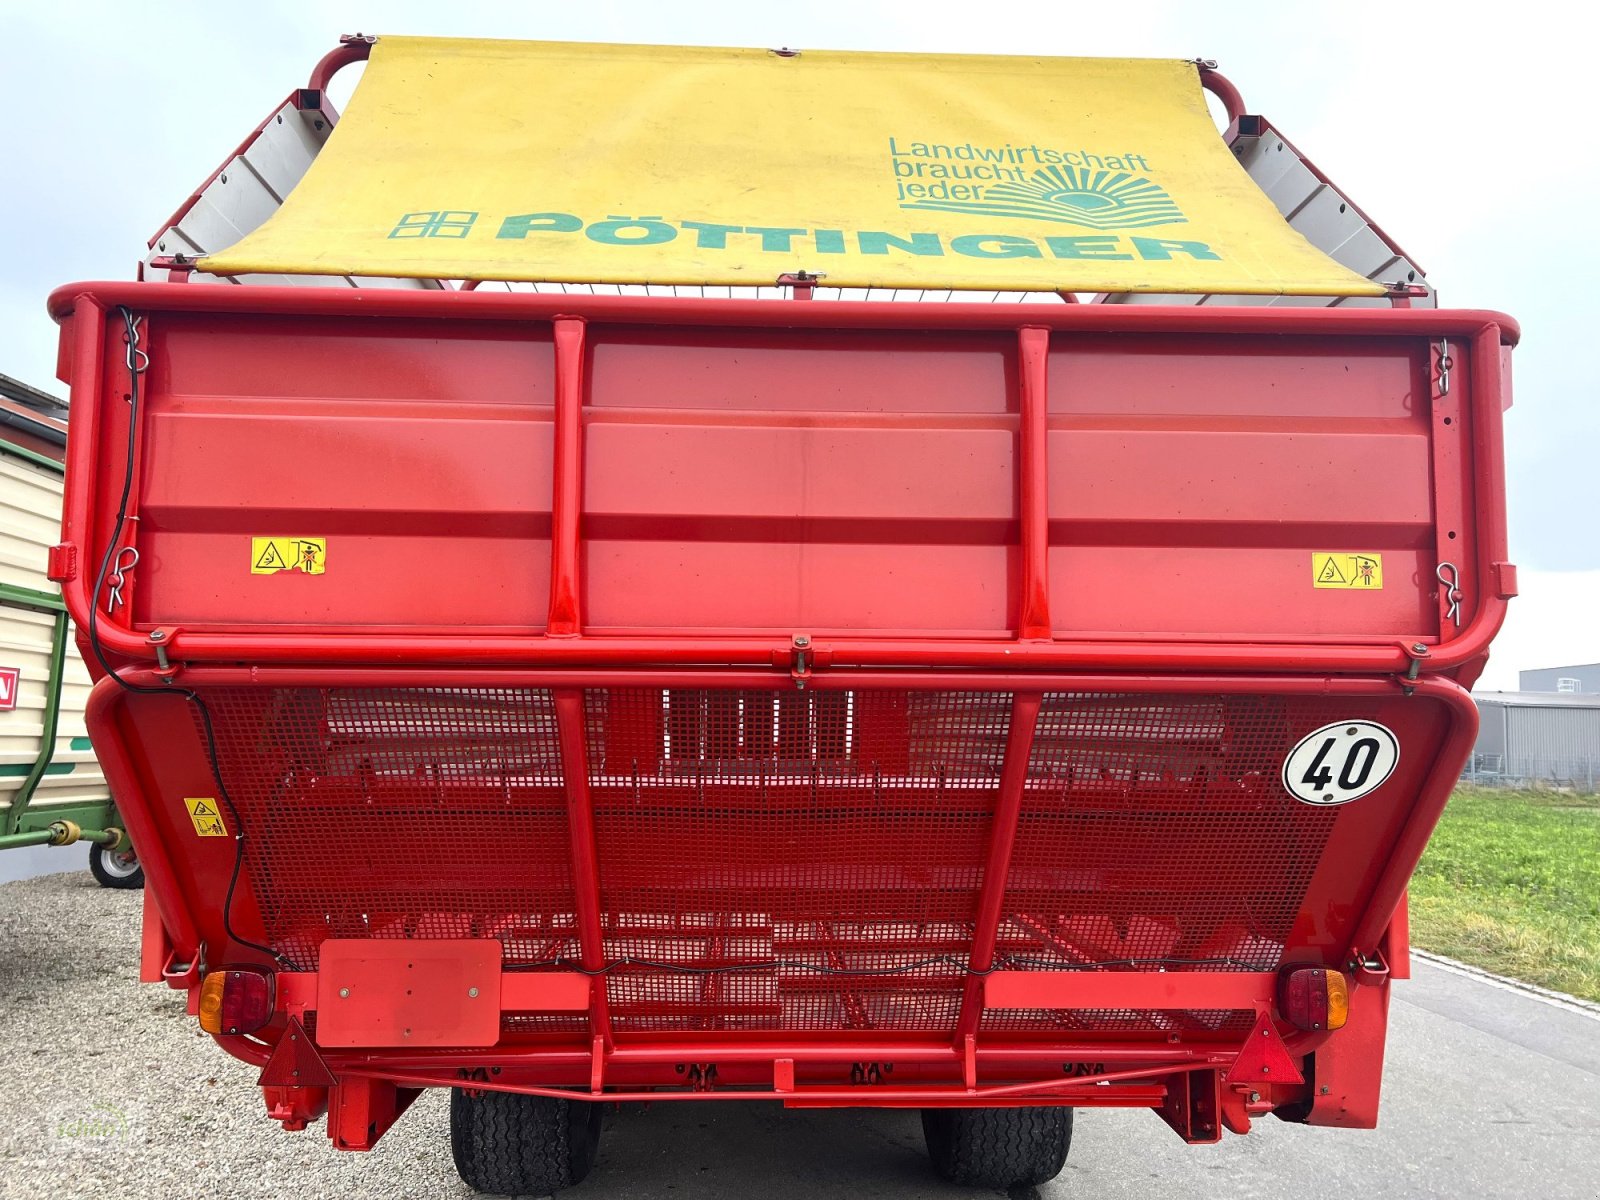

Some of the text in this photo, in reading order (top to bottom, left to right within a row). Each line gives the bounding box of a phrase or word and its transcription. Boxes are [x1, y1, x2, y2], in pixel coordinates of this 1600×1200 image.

[889, 137, 1153, 173] Landwirtschaft
[893, 157, 1029, 185] braucht
[896, 180, 984, 200] jeder
[495, 212, 1224, 260] PÖTTINGER
[1301, 737, 1380, 791] 40
